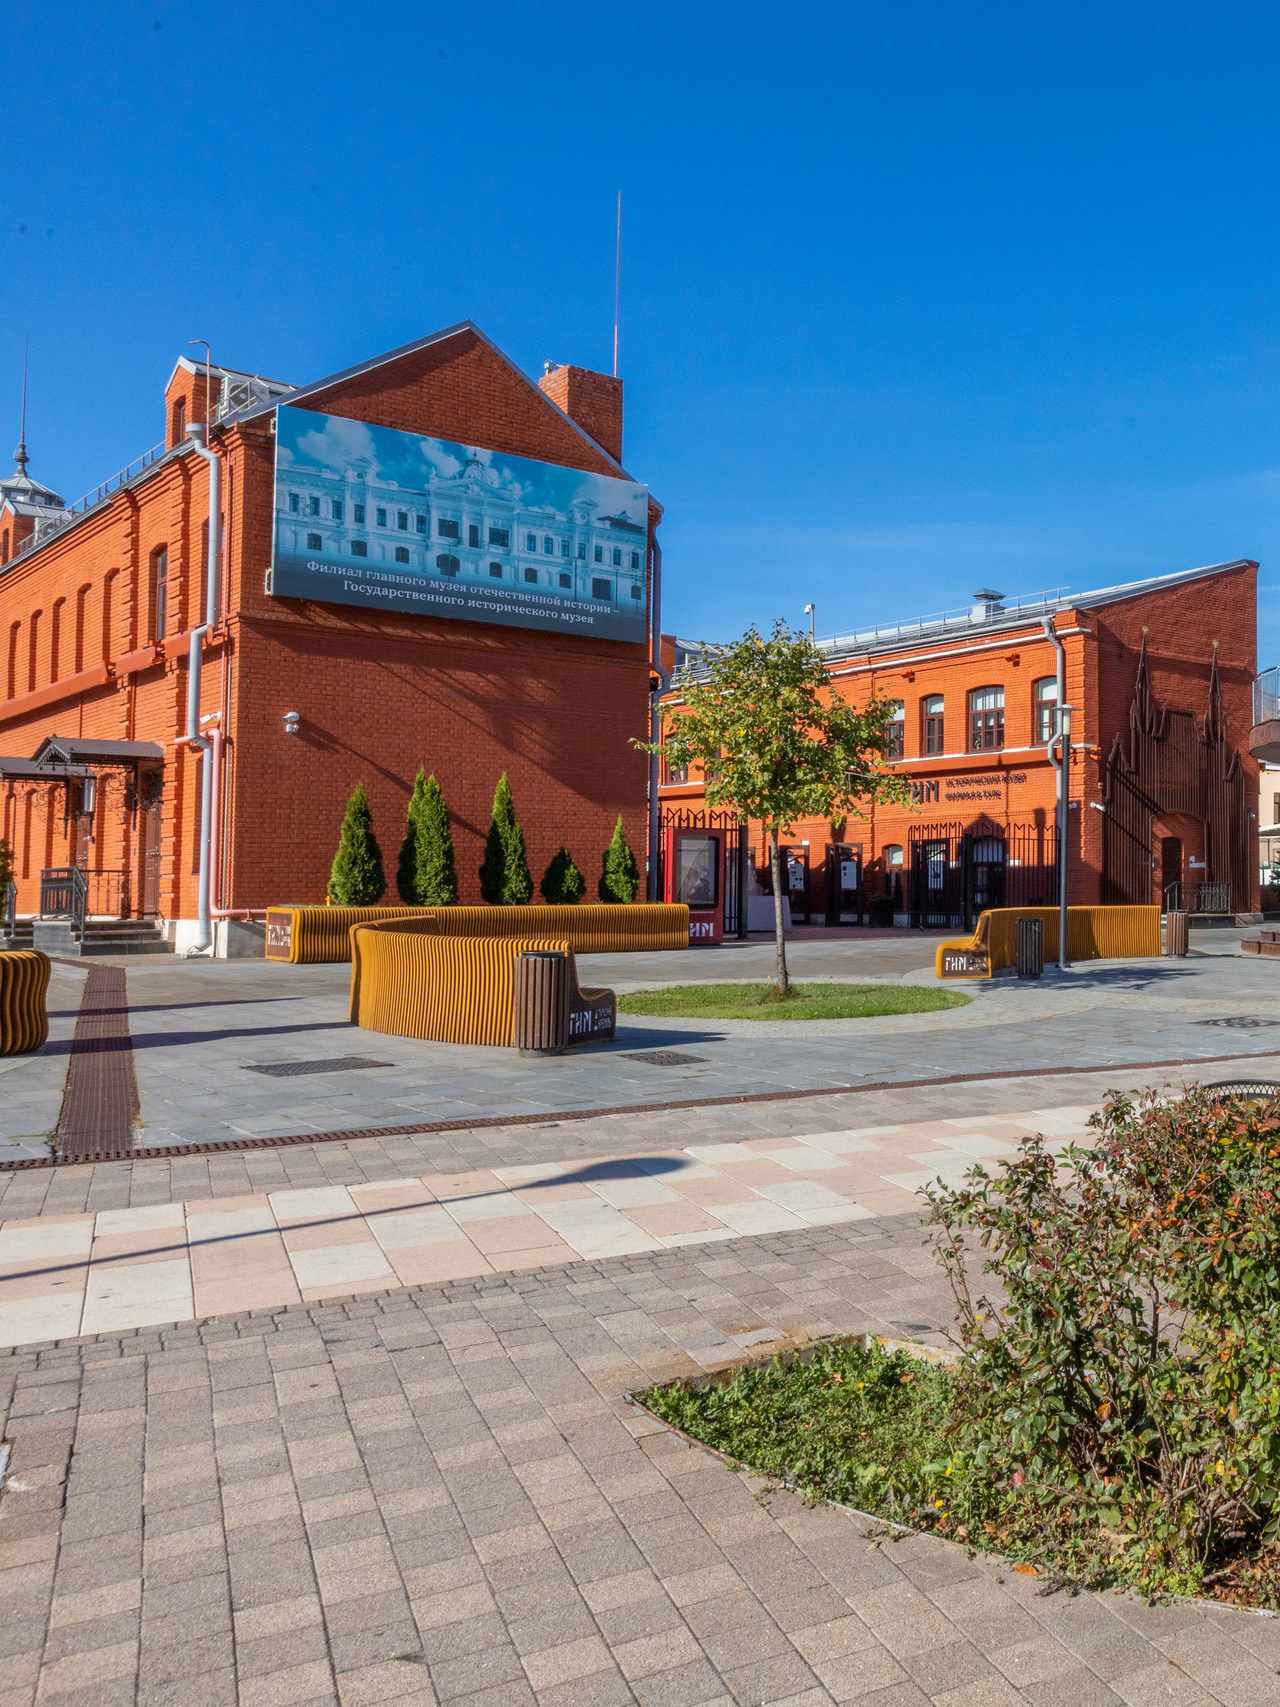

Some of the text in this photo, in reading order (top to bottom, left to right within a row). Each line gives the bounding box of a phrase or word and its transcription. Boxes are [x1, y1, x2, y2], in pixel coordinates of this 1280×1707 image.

[307, 561, 362, 578] Филиал
[366, 571, 426, 587] главного
[430, 580, 467, 592] музея
[470, 586, 561, 606] отечественной
[563, 600, 611, 614] истории
[344, 580, 594, 624] Государственного исторического музея
[907, 780, 939, 804] ИМ
